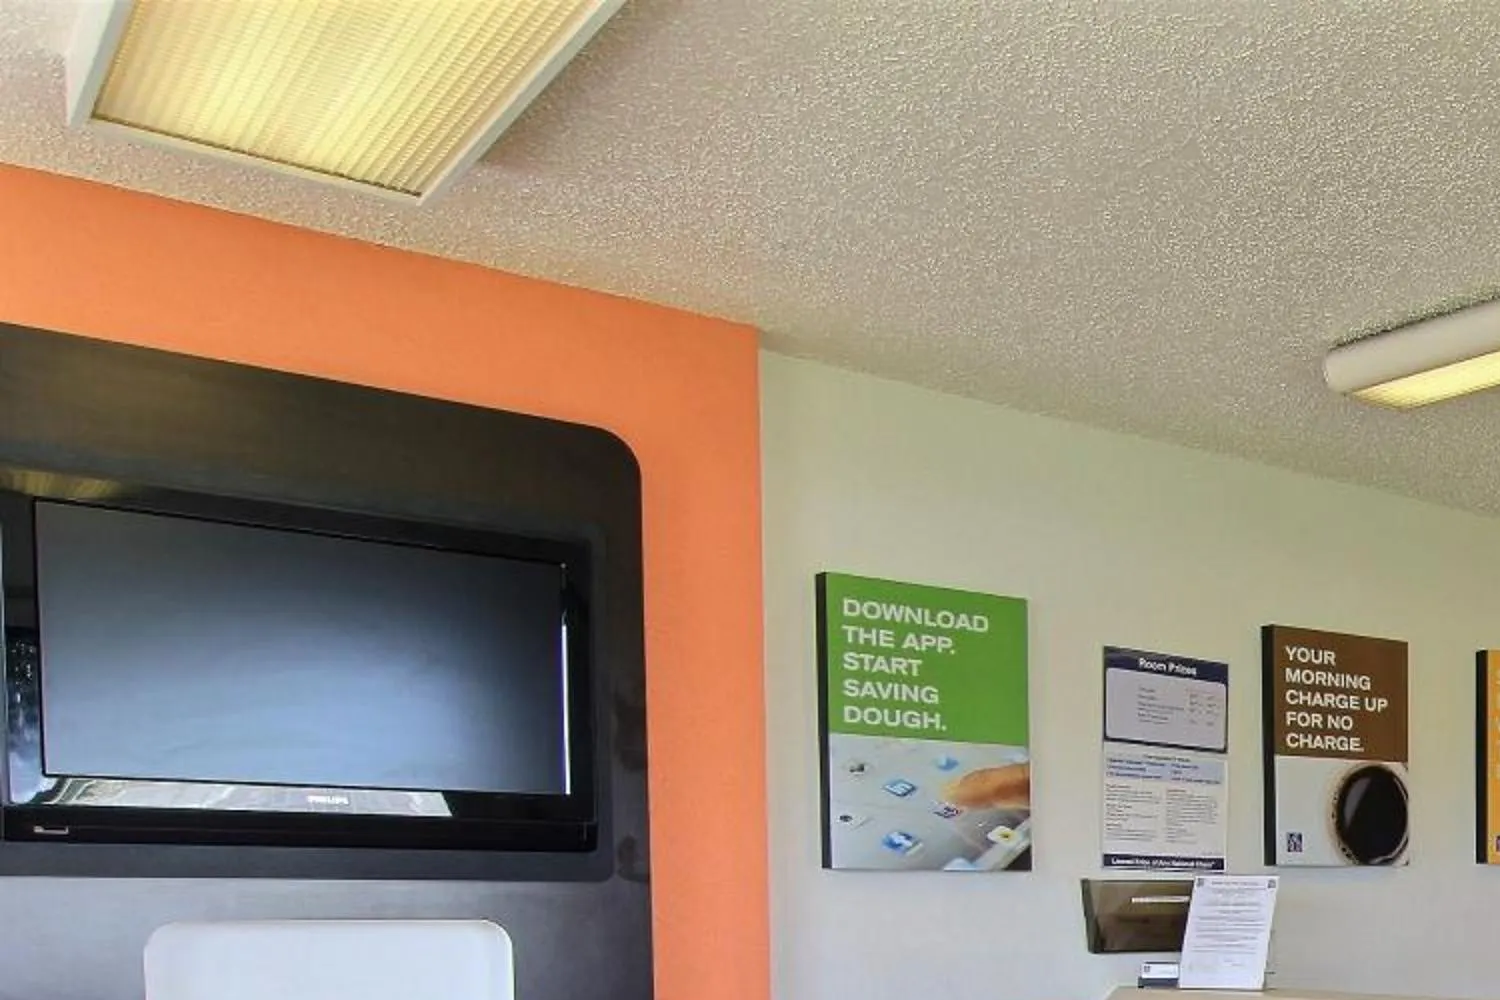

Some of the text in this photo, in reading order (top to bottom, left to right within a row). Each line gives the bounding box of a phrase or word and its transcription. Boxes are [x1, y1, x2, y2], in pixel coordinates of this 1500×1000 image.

[842, 597, 989, 633] DOWNLOAD
[841, 624, 956, 655] THE APP.
[843, 651, 923, 677] START
[1284, 645, 1337, 667] YOUR
[842, 678, 940, 705] SAVING
[1284, 667, 1372, 691] MORNING
[1285, 689, 1389, 713] CHARGE UP
[843, 704, 948, 732] DOUGH.
[1285, 711, 1354, 731] FOR NO
[1285, 732, 1365, 753] CHARGE.
